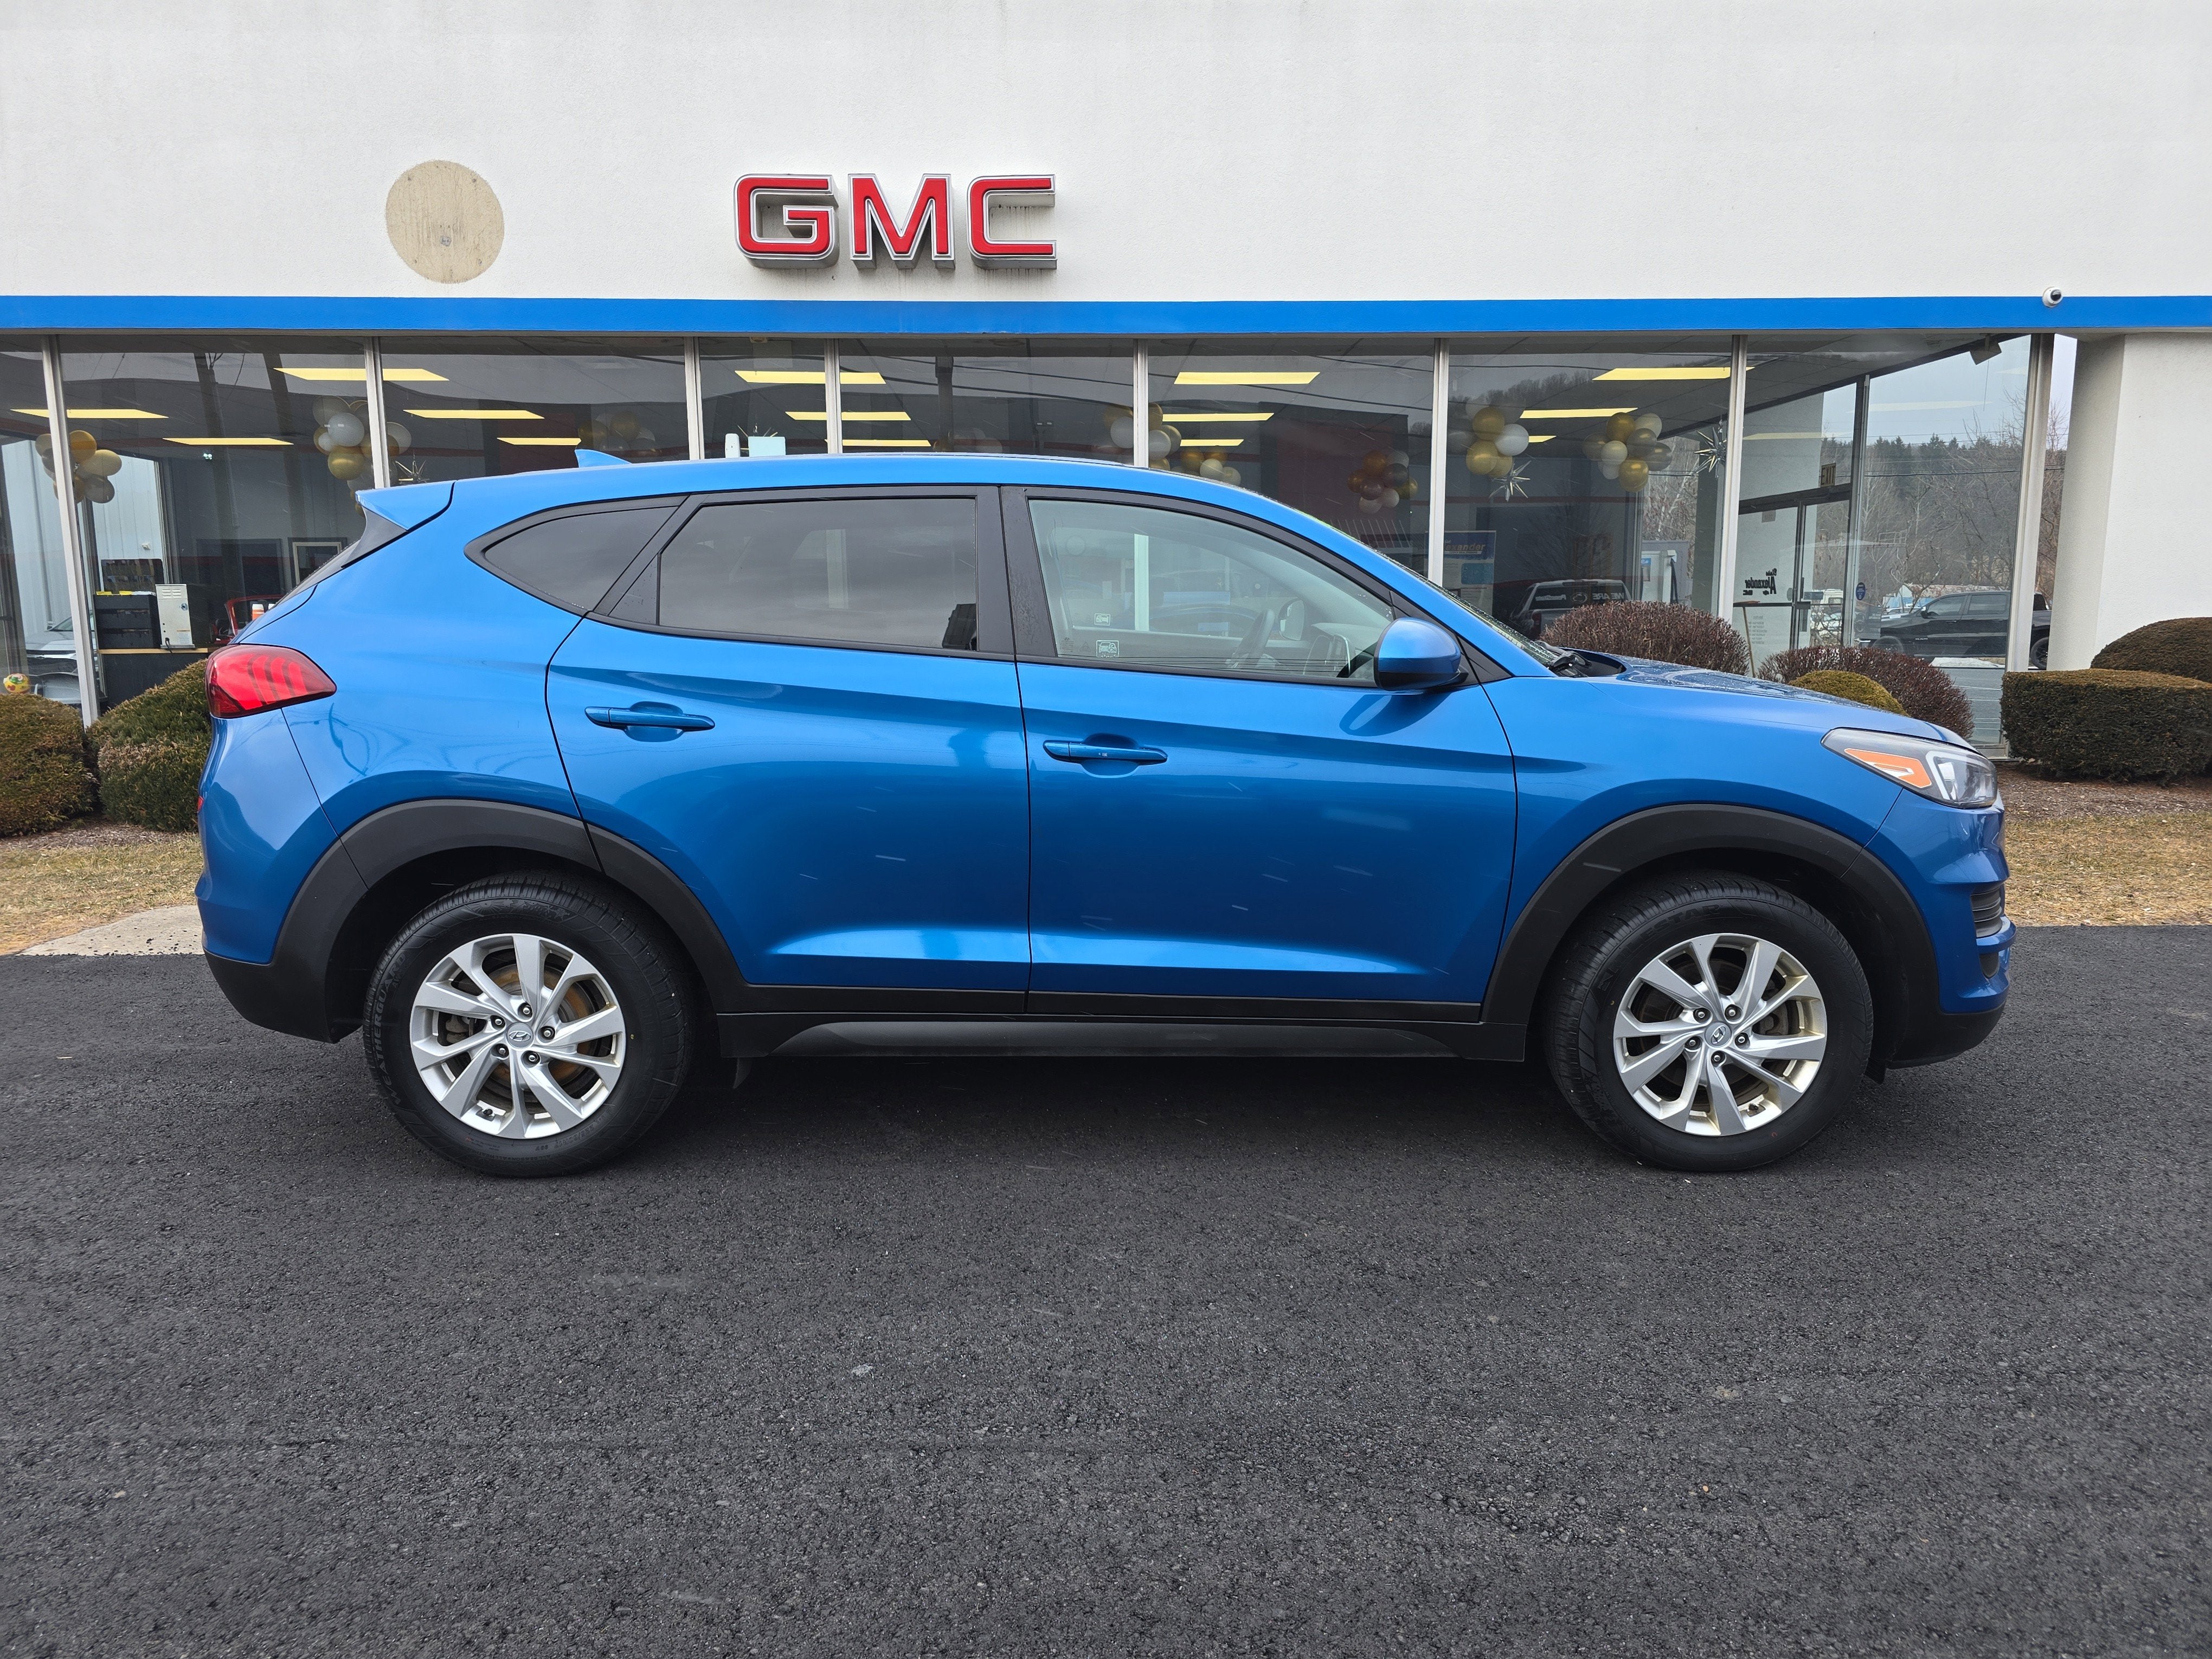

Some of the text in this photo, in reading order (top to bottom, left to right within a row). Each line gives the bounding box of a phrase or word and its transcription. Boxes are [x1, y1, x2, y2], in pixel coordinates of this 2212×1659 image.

[734, 173, 1057, 267] GMC
[1821, 465, 1836, 486] EXIT
[374, 953, 406, 1105] WEATHERGUARD
